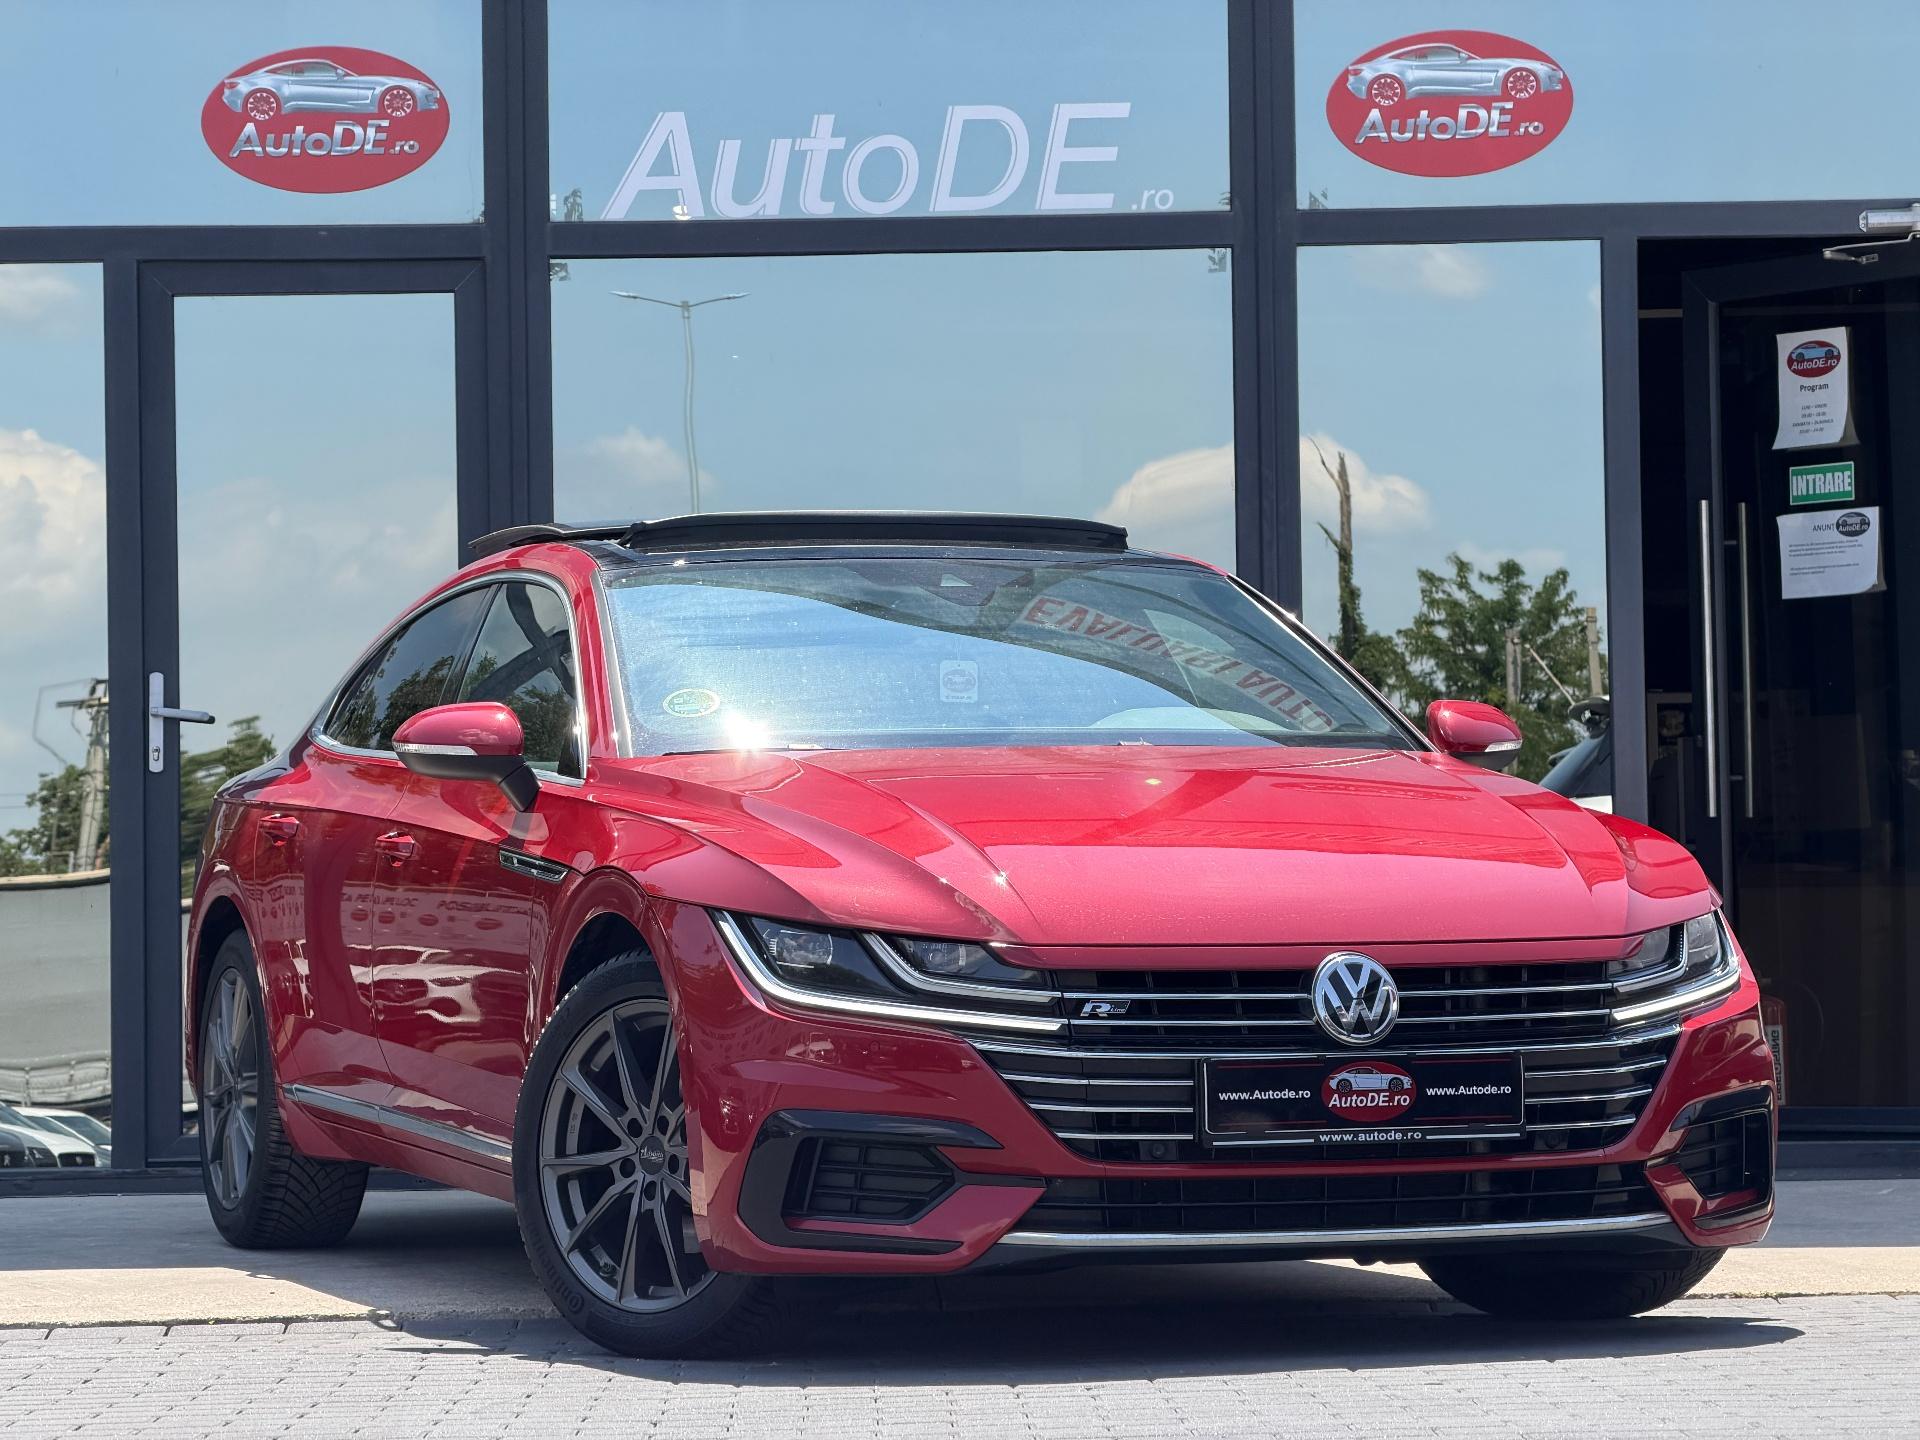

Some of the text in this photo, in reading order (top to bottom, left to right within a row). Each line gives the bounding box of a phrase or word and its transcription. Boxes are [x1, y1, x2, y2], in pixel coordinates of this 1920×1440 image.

[1354, 101, 1544, 144] AutoDE.ro
[229, 119, 420, 159] AutoDE.ro
[601, 101, 1174, 220] AutoDE.ro
[1790, 357, 1839, 370] AutoDE.ro
[1799, 382, 1829, 393] Program
[1792, 470, 1852, 497] INTRARE
[1218, 1083, 1512, 1109] www.Autode.ro AutoDE.ro www.Autode.ro
[1319, 1130, 1422, 1143] www.autode.ro
